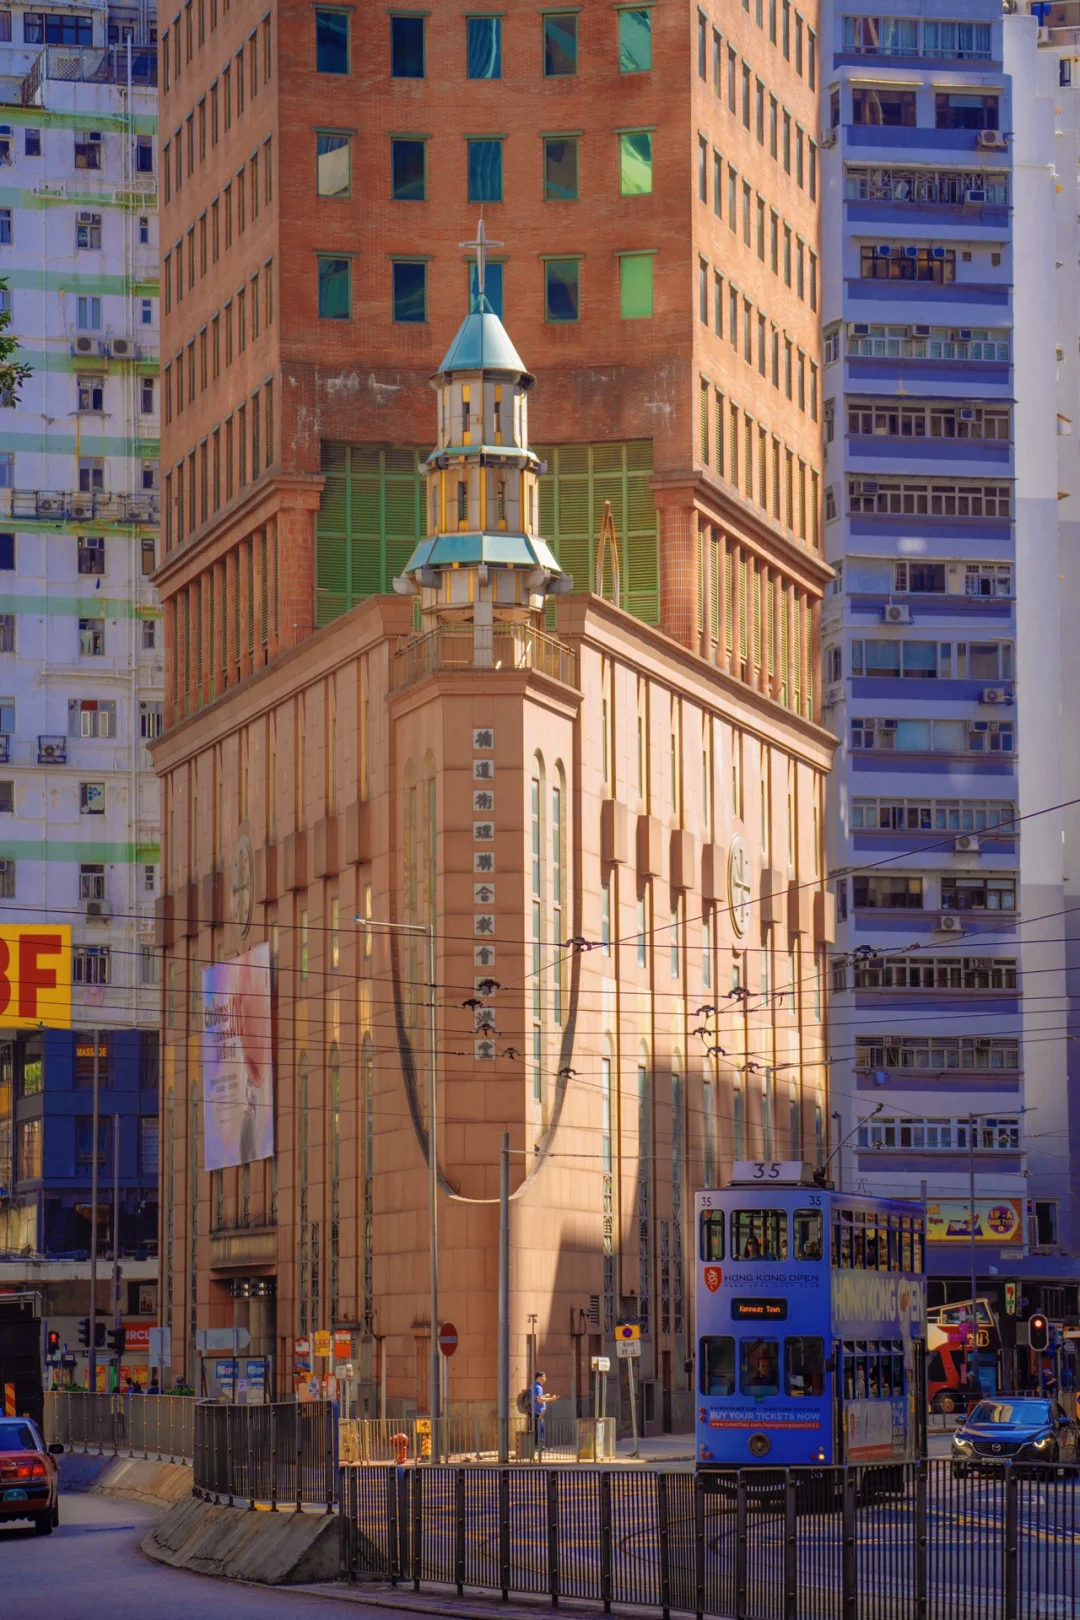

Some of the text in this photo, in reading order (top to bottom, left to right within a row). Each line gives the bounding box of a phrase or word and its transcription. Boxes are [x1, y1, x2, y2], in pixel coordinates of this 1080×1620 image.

[0, 934, 62, 1017] F
[76, 1047, 107, 1057] MASSGE
[752, 1162, 781, 1179] 35
[701, 1197, 712, 1207] 35
[809, 1195, 821, 1206] 35
[835, 1275, 866, 1321] HONG
[867, 1277, 897, 1321] KONG
[740, 1304, 764, 1312] Kennedy
[710, 1411, 725, 1419] BUY
[729, 1412, 754, 1420] YOUR
[756, 1412, 794, 1420] TICKETS
